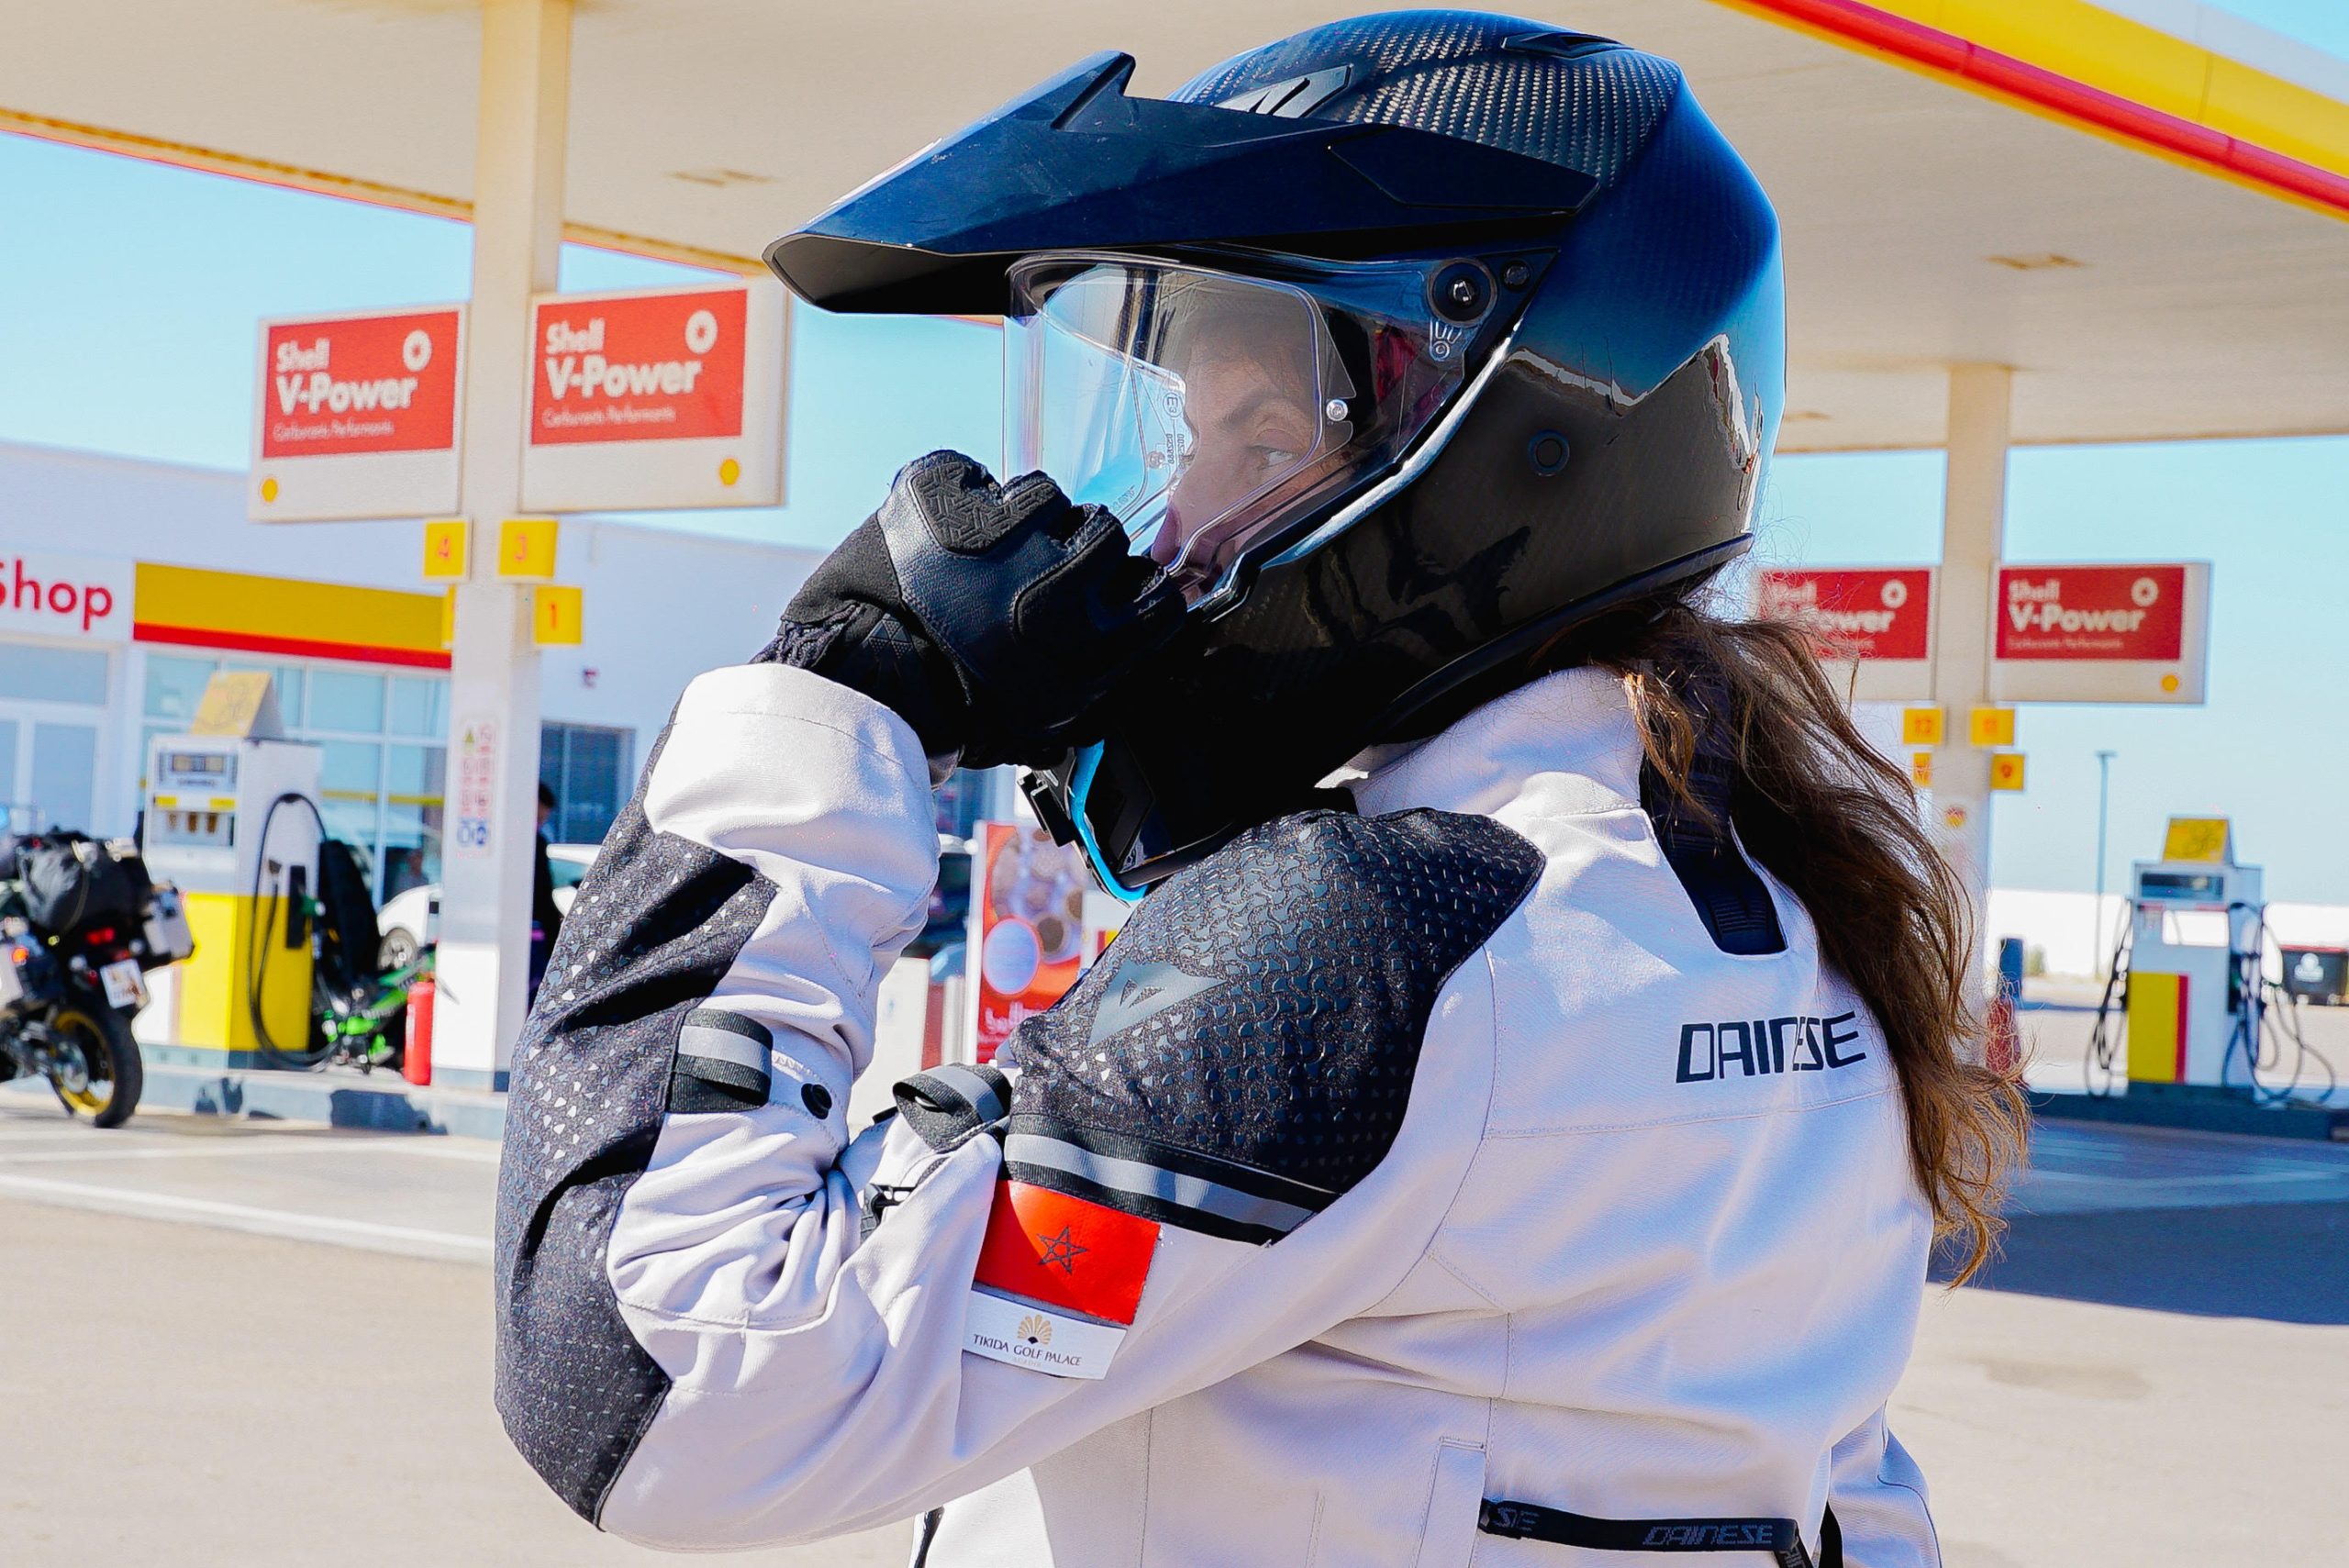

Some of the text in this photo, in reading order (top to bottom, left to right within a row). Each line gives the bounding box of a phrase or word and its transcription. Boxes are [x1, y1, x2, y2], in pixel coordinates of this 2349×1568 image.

[545, 317, 606, 354] Shell
[276, 338, 330, 373] Shell
[545, 354, 704, 400] V-Power
[276, 372, 419, 416] V-Power
[437, 536, 451, 562] 4
[514, 533, 529, 562] 3
[0, 559, 113, 630] hop
[2008, 578, 2061, 603] Shell
[550, 600, 558, 631] 1
[2008, 602, 2147, 633] V-Power
[974, 1334, 1083, 1366] TIKIDA GOLF PALACE
[1642, 1524, 1773, 1546] DAINESE
